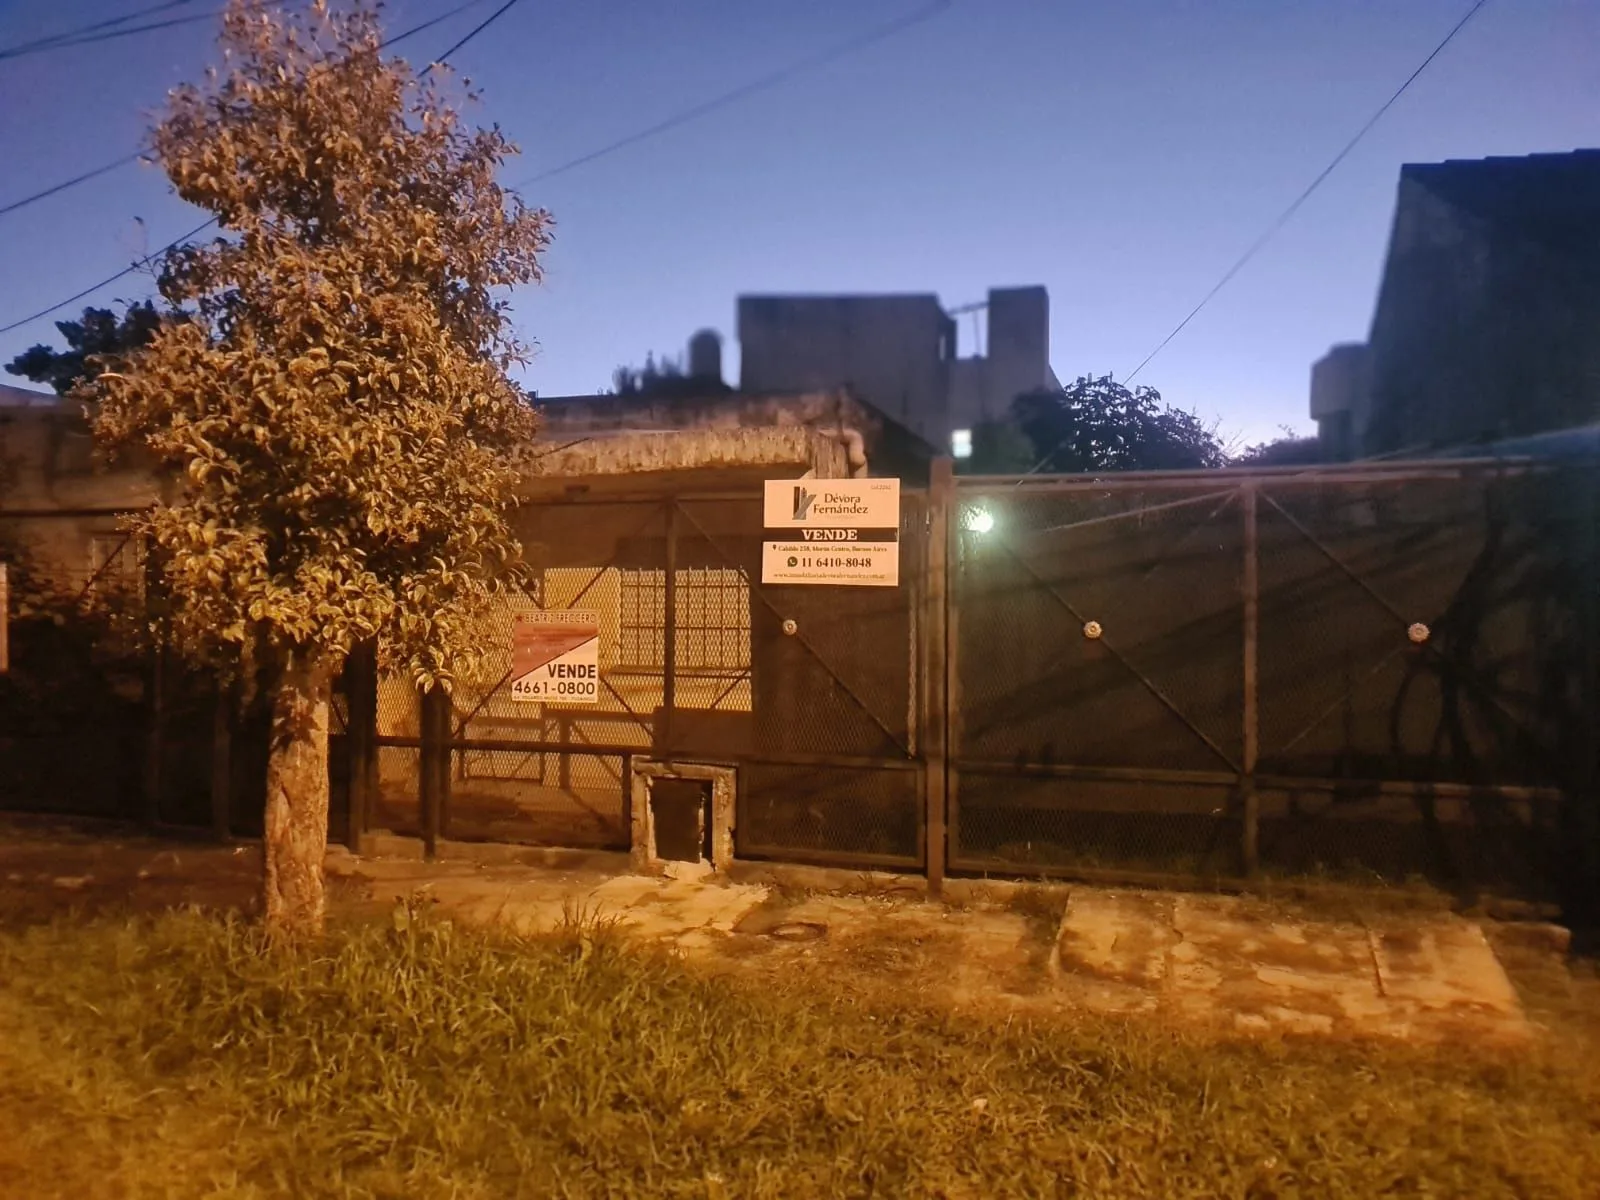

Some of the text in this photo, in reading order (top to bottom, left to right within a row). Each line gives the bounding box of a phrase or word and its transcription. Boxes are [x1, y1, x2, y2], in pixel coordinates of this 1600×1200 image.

[824, 493, 861, 503] Dévora
[813, 503, 869, 514] Fernández
[802, 529, 858, 540] VENDE
[802, 557, 872, 568] 11 6410-8048
[524, 613, 554, 624] BEATRIZ
[547, 664, 596, 679] VENDE
[514, 682, 595, 695] 4661-0800
